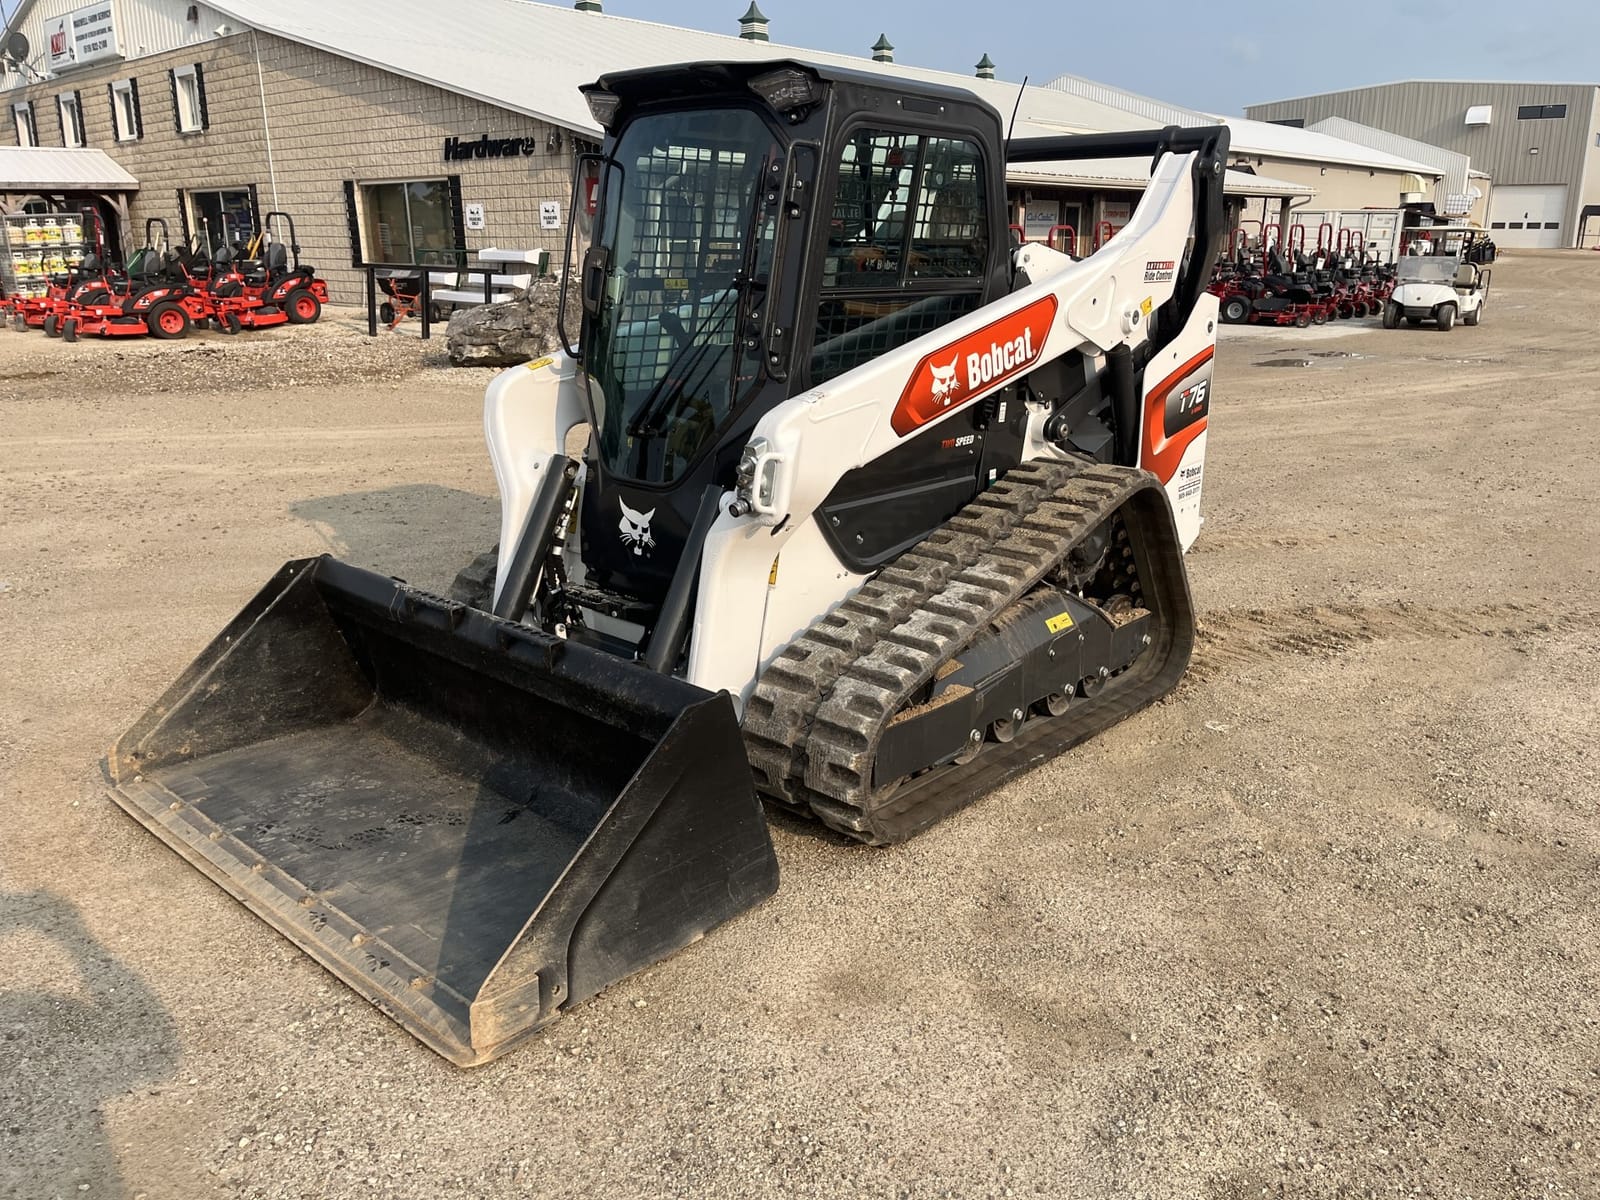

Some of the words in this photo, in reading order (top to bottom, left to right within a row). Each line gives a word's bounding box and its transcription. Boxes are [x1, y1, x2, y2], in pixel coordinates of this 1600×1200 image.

[50, 31, 67, 55] KIOTI
[444, 134, 536, 161] Hardware
[1144, 271, 1156, 281] Ride
[1155, 270, 1174, 280] Control
[966, 326, 1032, 391] Bobcat
[1180, 379, 1207, 414] T76
[942, 438, 956, 449] TWO
[955, 434, 975, 448] SPEED
[1186, 464, 1202, 479] Bobcat
